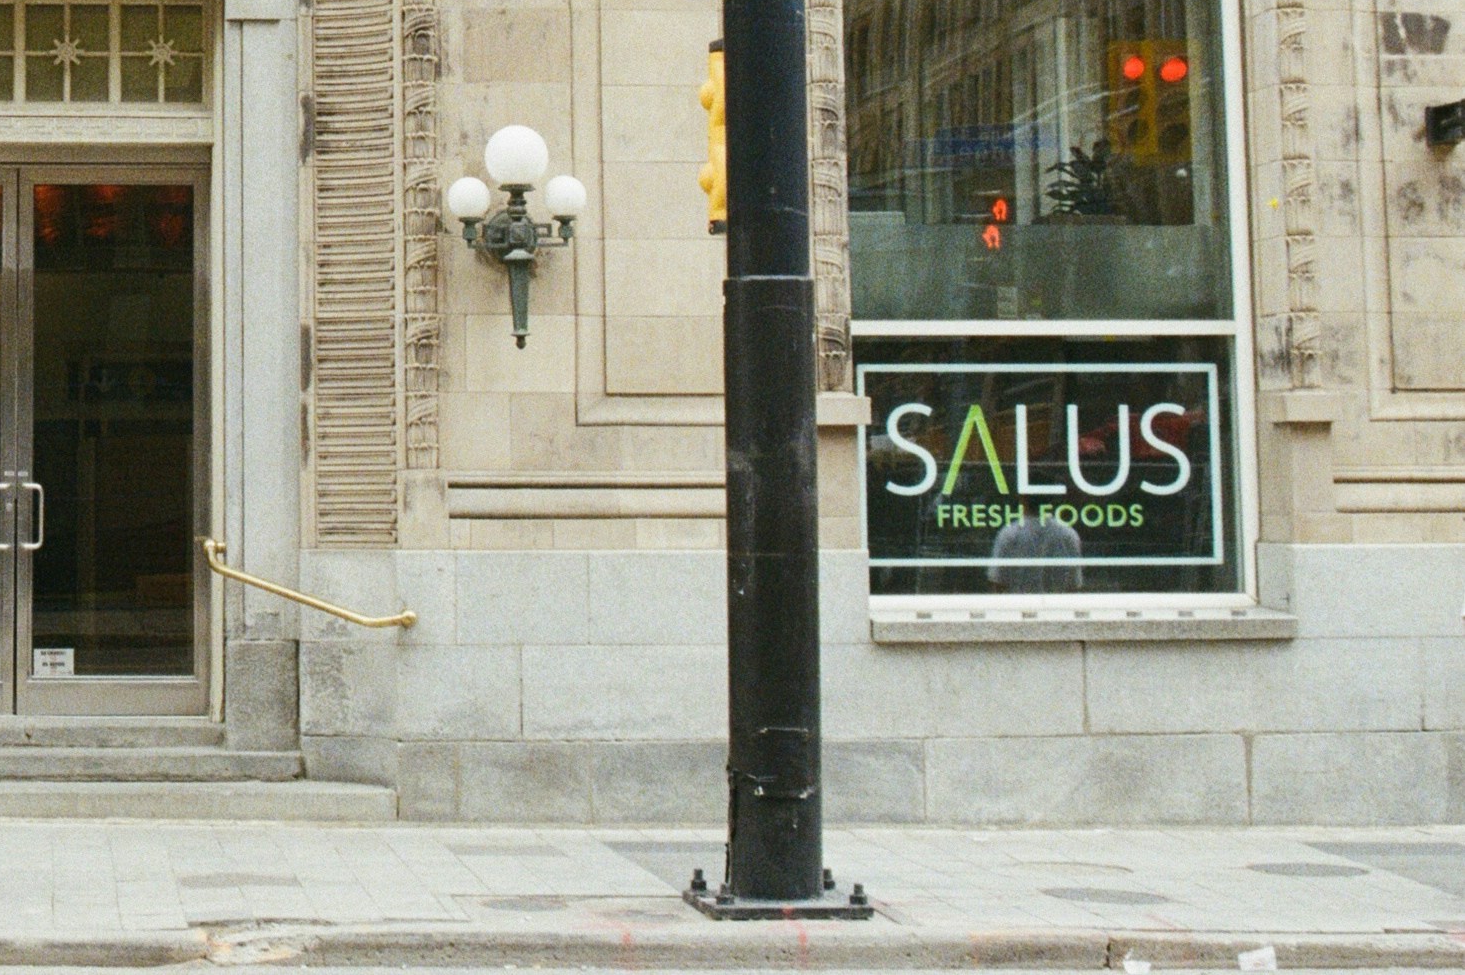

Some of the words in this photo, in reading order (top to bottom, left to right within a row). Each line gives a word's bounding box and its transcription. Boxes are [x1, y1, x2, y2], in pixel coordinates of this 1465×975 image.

[885, 402, 1192, 497] SALUS
[937, 503, 1024, 529] FRESH
[1038, 503, 1144, 528] FOODS
